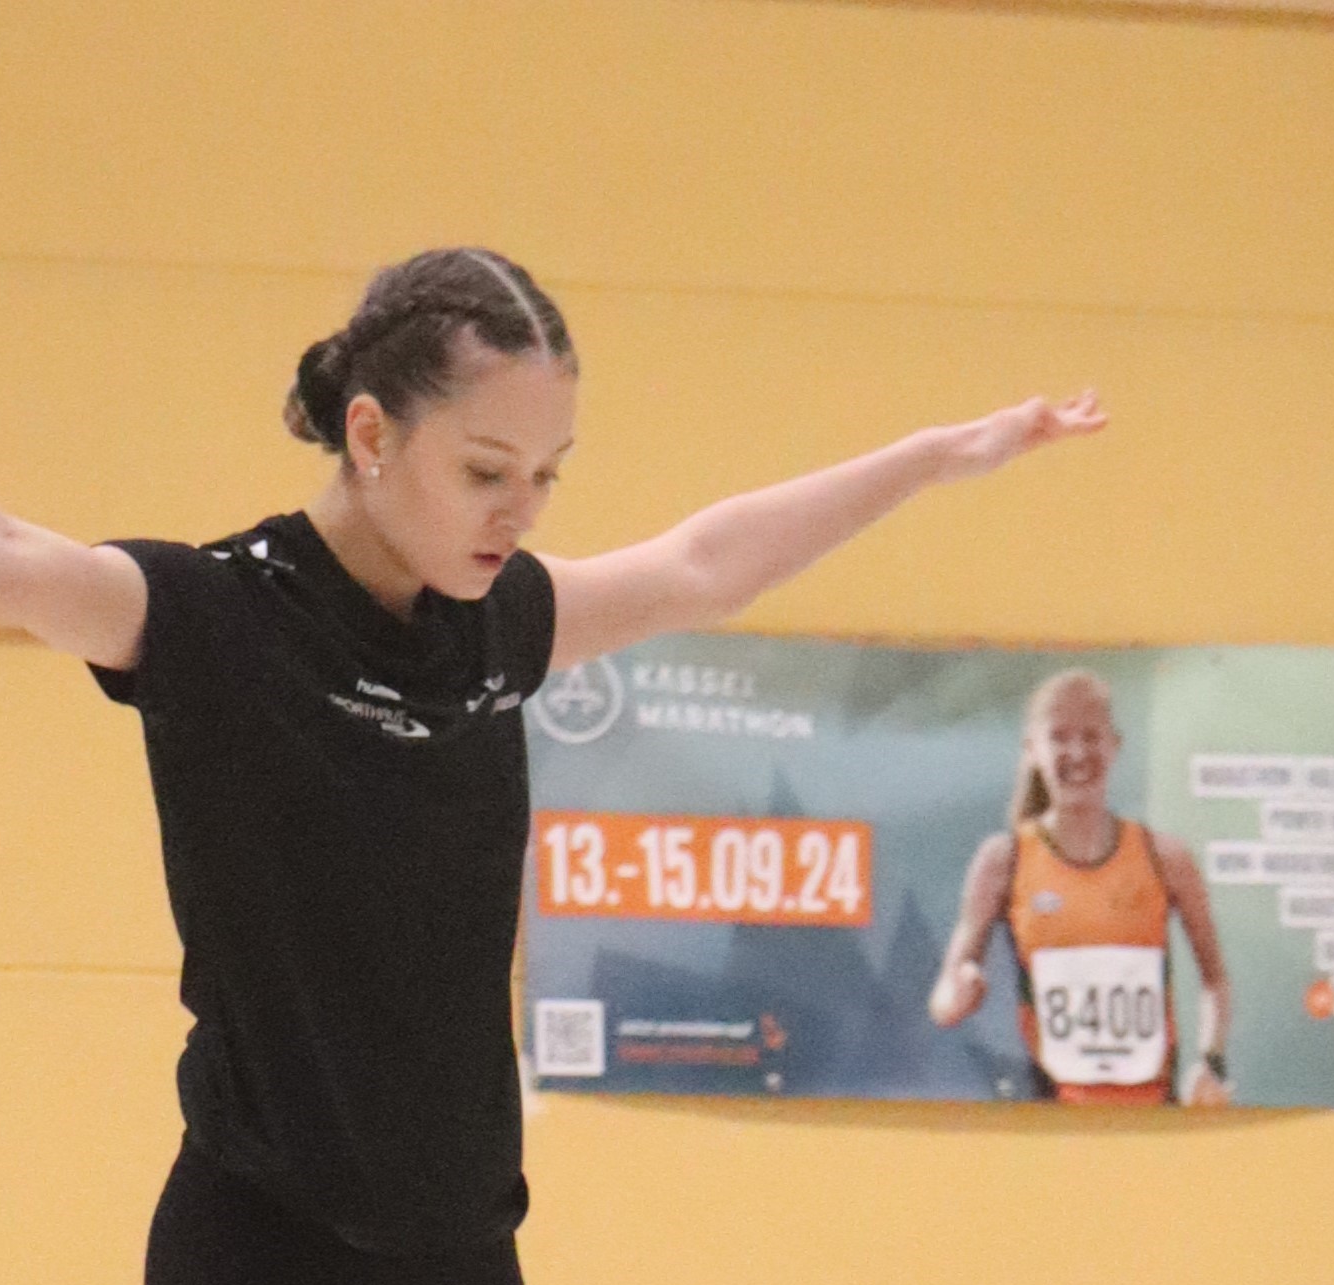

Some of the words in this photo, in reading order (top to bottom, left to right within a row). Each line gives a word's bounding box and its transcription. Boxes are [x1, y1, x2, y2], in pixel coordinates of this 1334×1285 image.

[637, 704, 814, 739] MARATHON
[544, 822, 862, 915] 13.-15.09.24
[1045, 984, 1161, 1040] 8400
